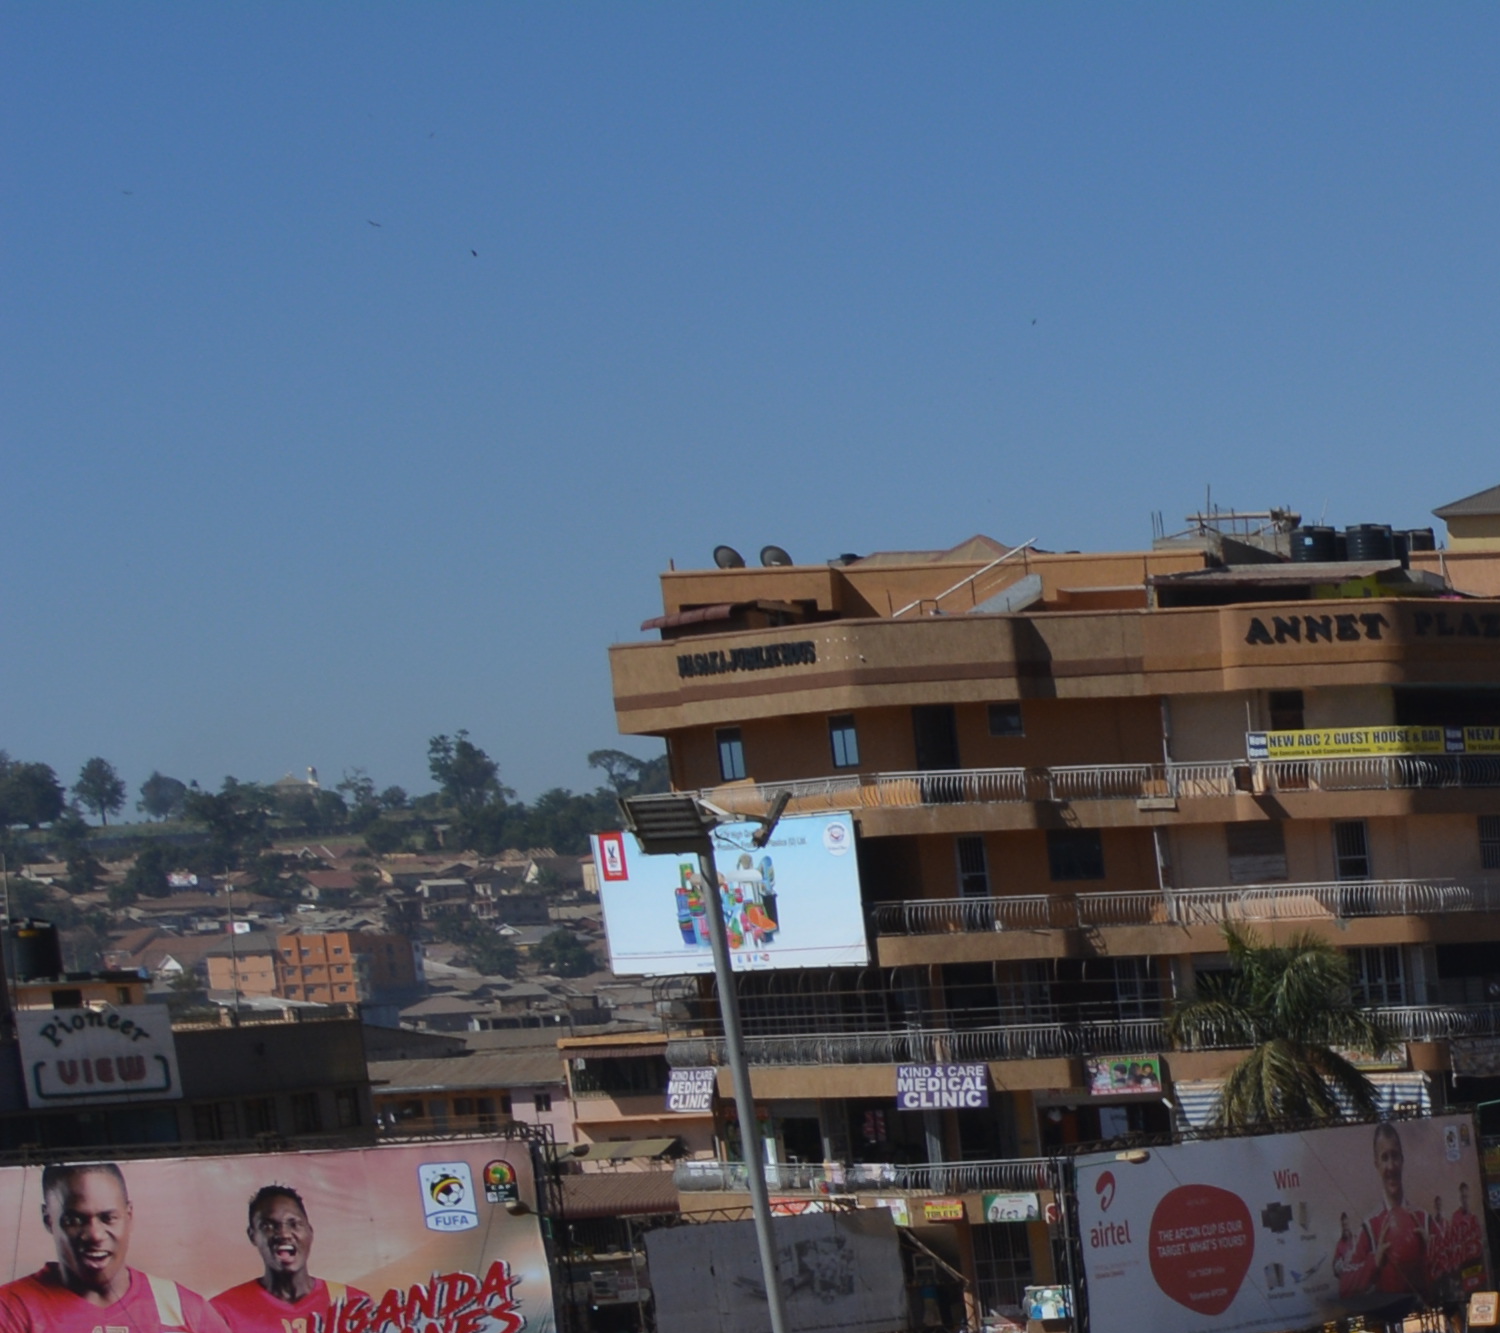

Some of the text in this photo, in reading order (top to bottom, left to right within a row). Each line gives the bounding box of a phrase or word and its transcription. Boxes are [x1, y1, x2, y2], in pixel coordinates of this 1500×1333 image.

[1244, 611, 1389, 646] ANNET
[1269, 731, 1297, 748] NEW
[1298, 730, 1321, 747] ABC
[1323, 730, 1332, 746] 2
[1334, 728, 1370, 746] GUEST
[1372, 727, 1412, 745] HOUSE
[1422, 727, 1442, 743] BAR
[40, 1012, 150, 1047] Pioneer
[56, 1055, 147, 1086] VIEW
[897, 1077, 987, 1092] MEDICAL
[669, 1094, 711, 1111] CLINIC
[903, 1091, 983, 1109] CLINIC
[1273, 1168, 1300, 1190] Win
[435, 1213, 470, 1227] FUFA
[1091, 1219, 1132, 1248] airtel
